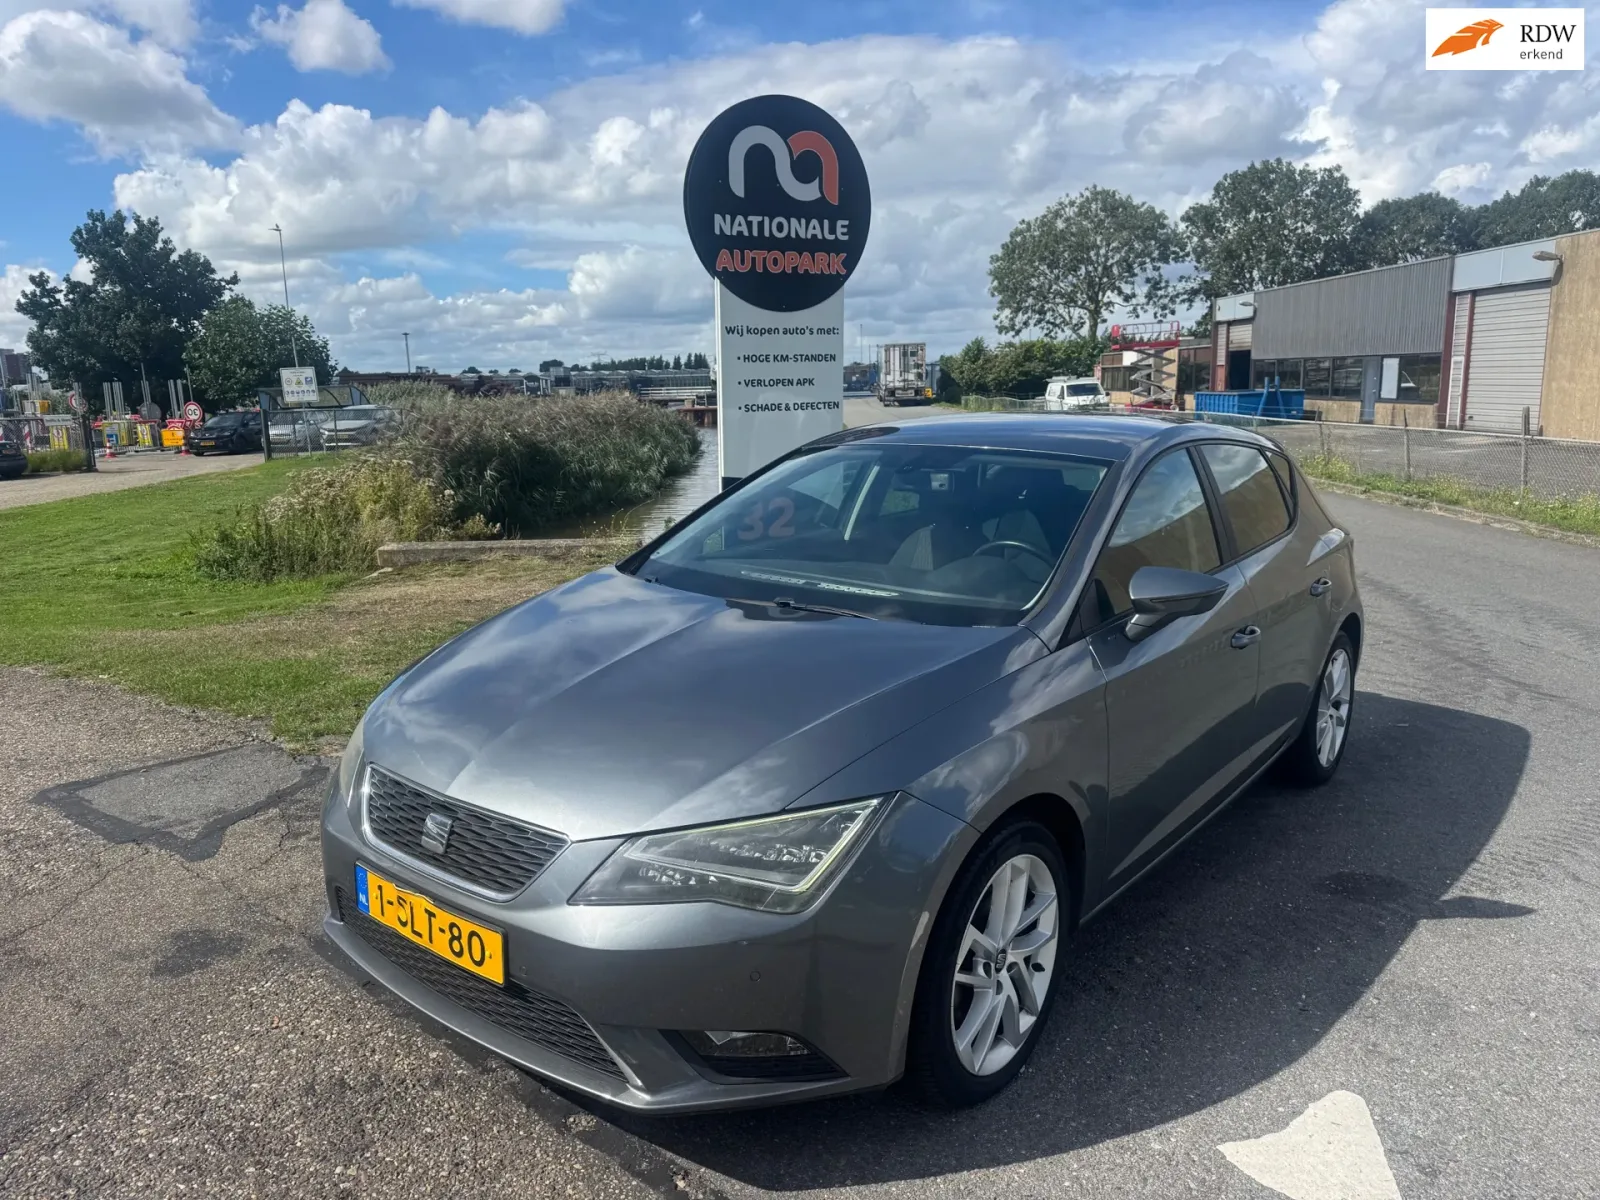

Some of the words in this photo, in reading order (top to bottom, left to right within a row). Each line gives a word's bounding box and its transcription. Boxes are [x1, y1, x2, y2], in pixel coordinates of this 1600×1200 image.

[713, 213, 850, 241] NATIONALE
[715, 248, 847, 275] AUTOPARK
[725, 325, 744, 337] Wij
[746, 325, 780, 337] kopen
[782, 325, 814, 336] auto's
[816, 326, 840, 336] met:
[743, 354, 771, 363] HOGE
[773, 353, 836, 363] KM-STANDEN
[743, 379, 794, 387] VERLOPEN
[795, 378, 815, 387] APK
[744, 403, 783, 412] SCHADE
[784, 403, 791, 411] &
[793, 401, 840, 411] DEFECTEN
[737, 497, 795, 540] 32
[359, 892, 368, 905] NL
[377, 884, 486, 968] 1-SLT-80
